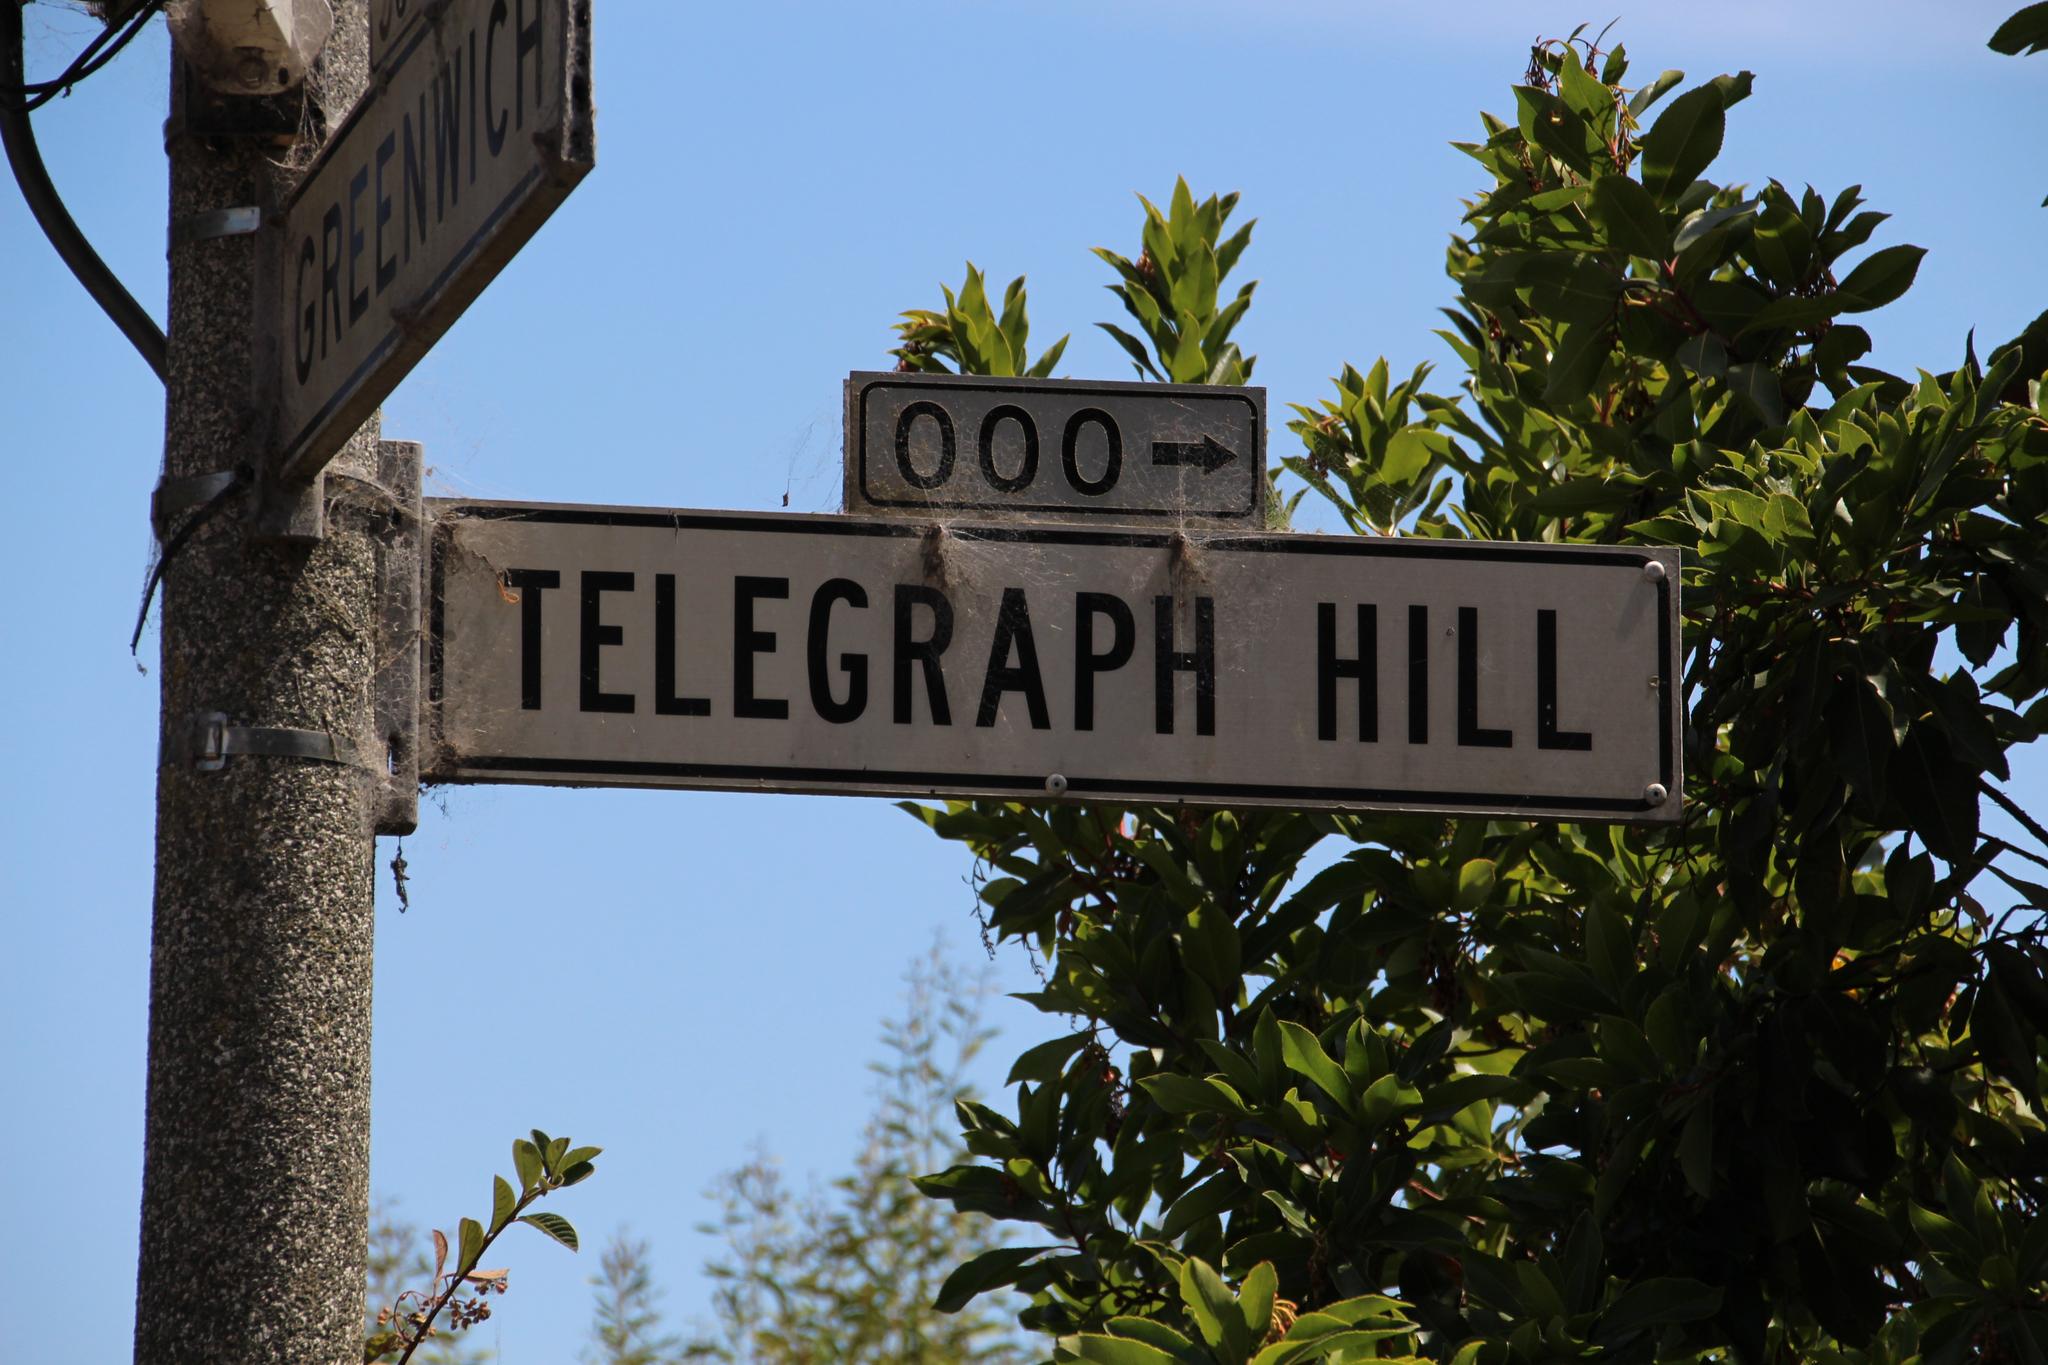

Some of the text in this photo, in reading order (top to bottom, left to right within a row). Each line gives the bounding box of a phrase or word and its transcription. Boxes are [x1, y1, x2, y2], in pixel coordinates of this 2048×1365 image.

[296, 0, 542, 386] GREENWICH
[505, 569, 1593, 751] TELEGRAPH HILL
